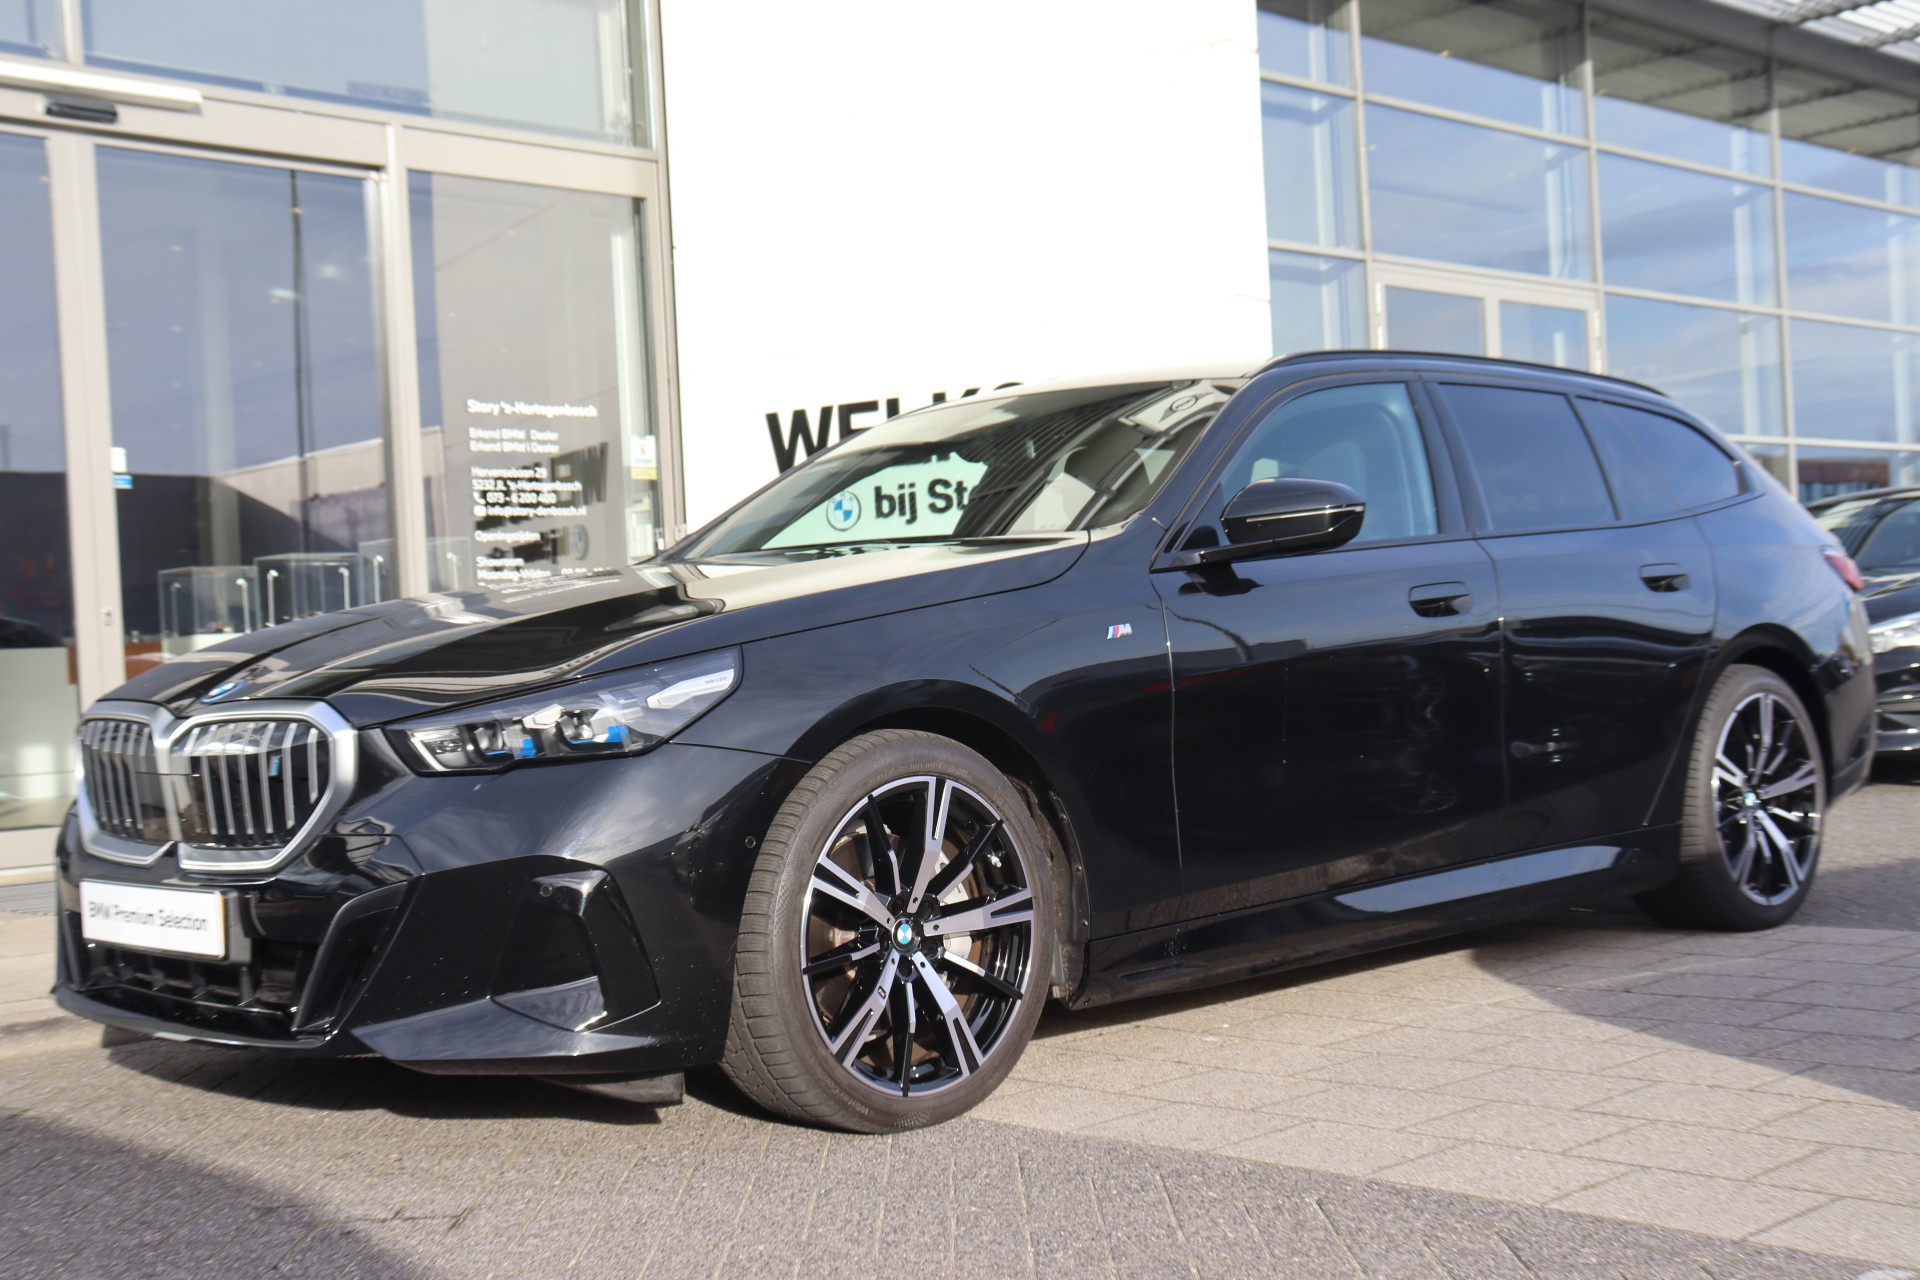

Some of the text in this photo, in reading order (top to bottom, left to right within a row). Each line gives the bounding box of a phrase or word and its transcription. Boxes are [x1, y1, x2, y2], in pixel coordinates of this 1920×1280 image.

[467, 399, 500, 416] Story
[469, 427, 560, 442] Erkend BMW Dealer
[470, 440, 502, 452] Erkend
[502, 441, 527, 453] BMW
[531, 442, 560, 454] Dealer
[486, 492, 505, 503] 073
[518, 492, 538, 504] 200
[538, 493, 557, 505] 400
[874, 478, 974, 525] bij St
[476, 556, 525, 568] Showroom
[88, 900, 209, 932] BMW Premium Selection
